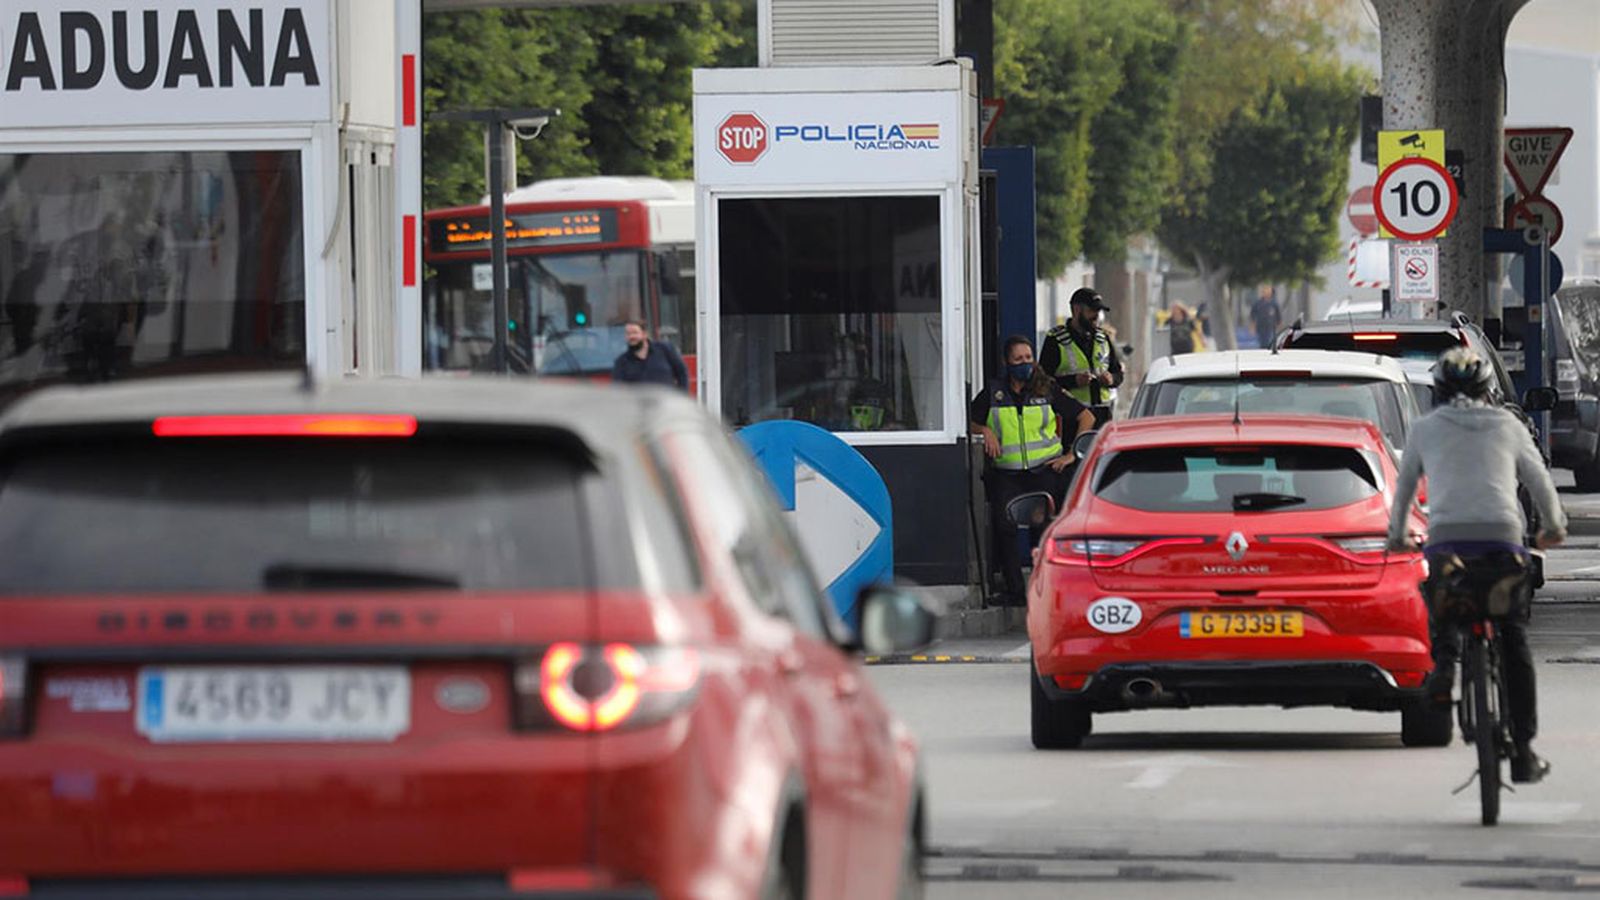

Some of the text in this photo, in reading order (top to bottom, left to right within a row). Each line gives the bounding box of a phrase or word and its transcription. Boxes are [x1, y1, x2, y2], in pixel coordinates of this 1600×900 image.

[5, 8, 320, 91] ADUANA
[721, 126, 764, 150] STOP
[854, 140, 939, 150] NACIONAL
[1508, 136, 1552, 151] GIVE
[1516, 154, 1549, 166] WAY
[1390, 180, 1441, 217] 10
[97, 609, 442, 631] DISCOVERY
[1091, 605, 1134, 625] GBZ
[175, 673, 292, 722] 4569
[308, 672, 397, 723] JCY
